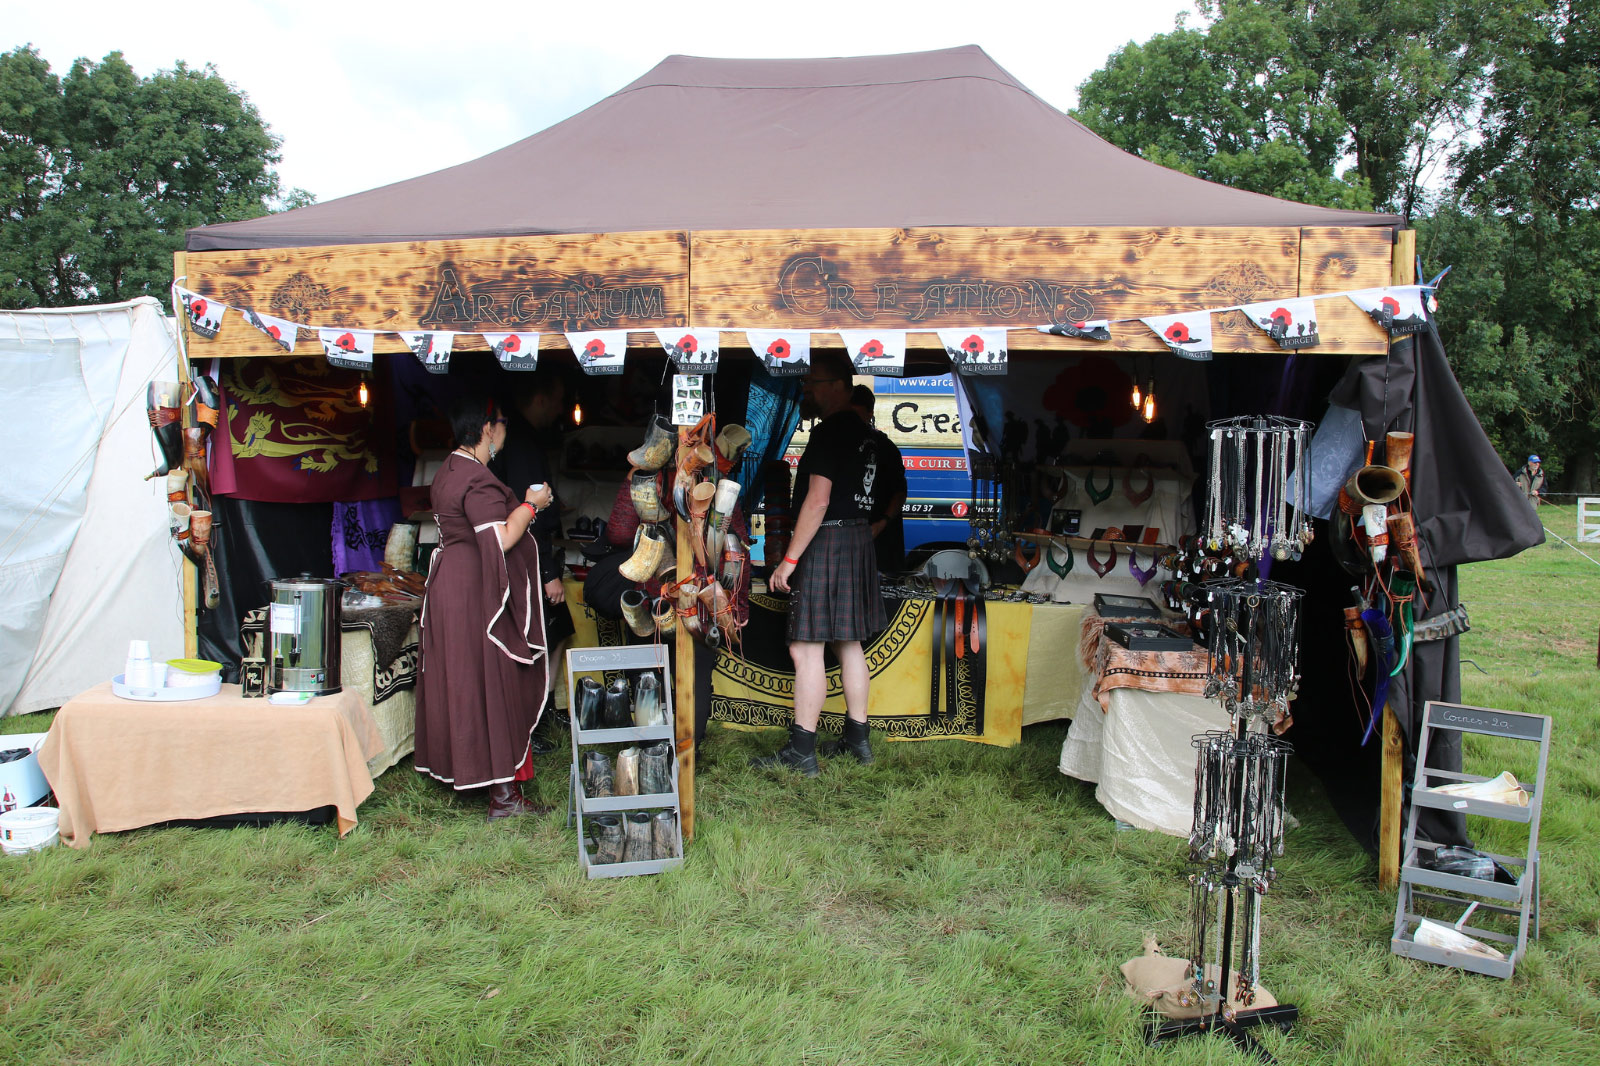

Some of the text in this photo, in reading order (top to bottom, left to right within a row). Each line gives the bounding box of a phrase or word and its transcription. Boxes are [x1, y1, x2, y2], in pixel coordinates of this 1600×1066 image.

[1391, 323, 1425, 334] FORGET
[1284, 336, 1315, 347] FORGET
[1182, 350, 1210, 359] FORGET
[344, 361, 369, 369] FORGET
[508, 362, 535, 370] FORGET
[595, 365, 620, 373] FORGET
[687, 364, 713, 372] FORGET
[974, 362, 1003, 372] FORGET
[781, 367, 808, 375] FORGET
[871, 366, 900, 374] FORGET
[919, 459, 950, 469] CUIR
[911, 504, 922, 512] 67
[923, 504, 934, 512] 37
